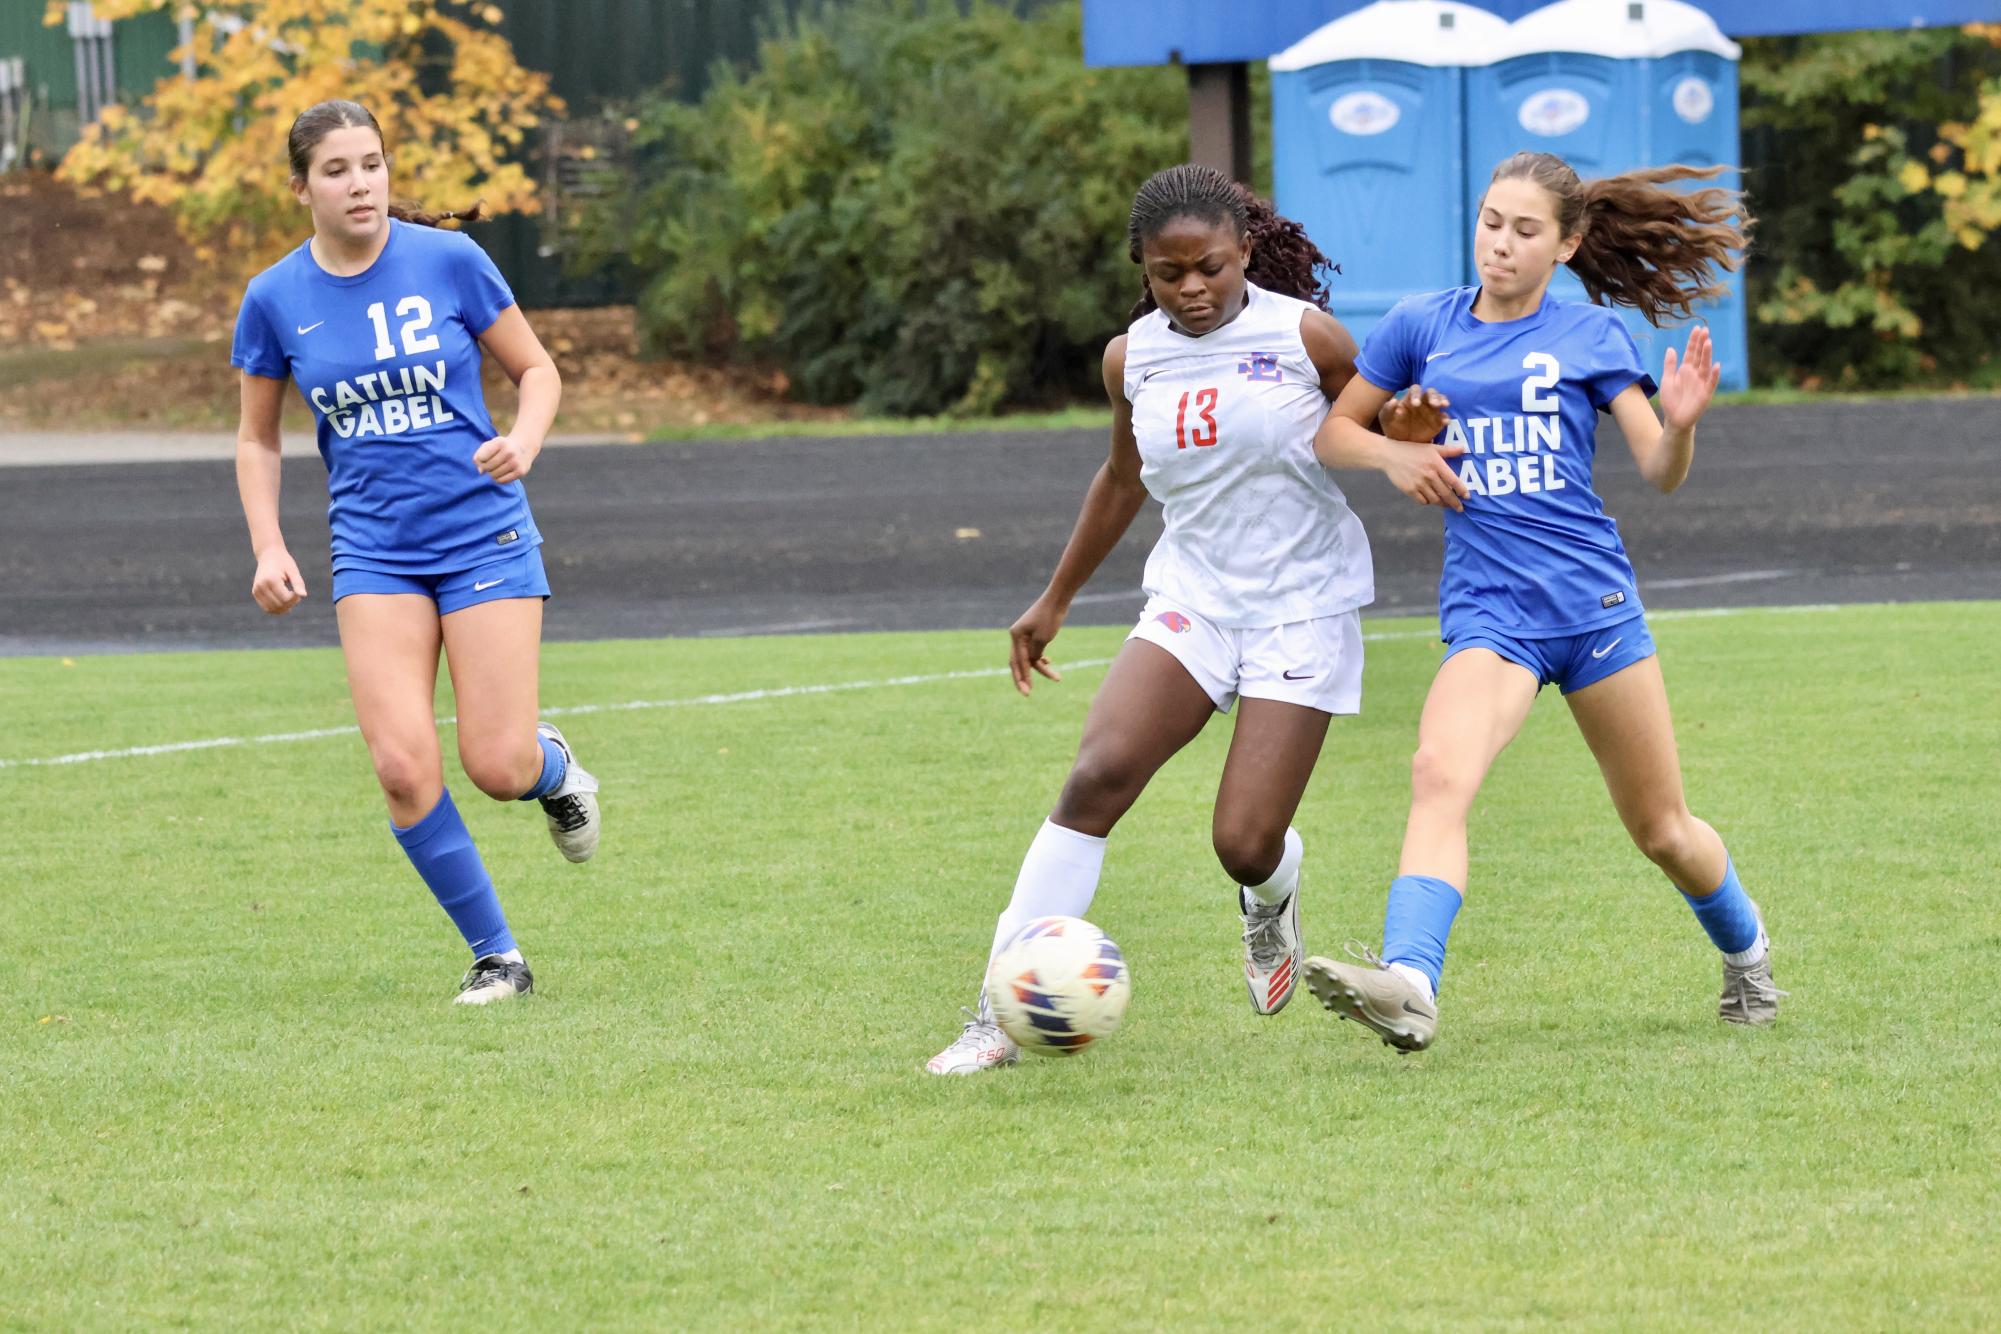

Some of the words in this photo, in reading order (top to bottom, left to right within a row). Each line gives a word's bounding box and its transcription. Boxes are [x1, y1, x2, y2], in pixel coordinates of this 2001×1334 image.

[367, 295, 440, 361] 12
[311, 360, 446, 414] CATLIN
[1522, 352, 1560, 413] 2
[327, 395, 454, 438] GABEL
[1175, 388, 1218, 449] 13
[1443, 415, 1561, 454] ATLIN
[1456, 455, 1566, 496] ABEL
